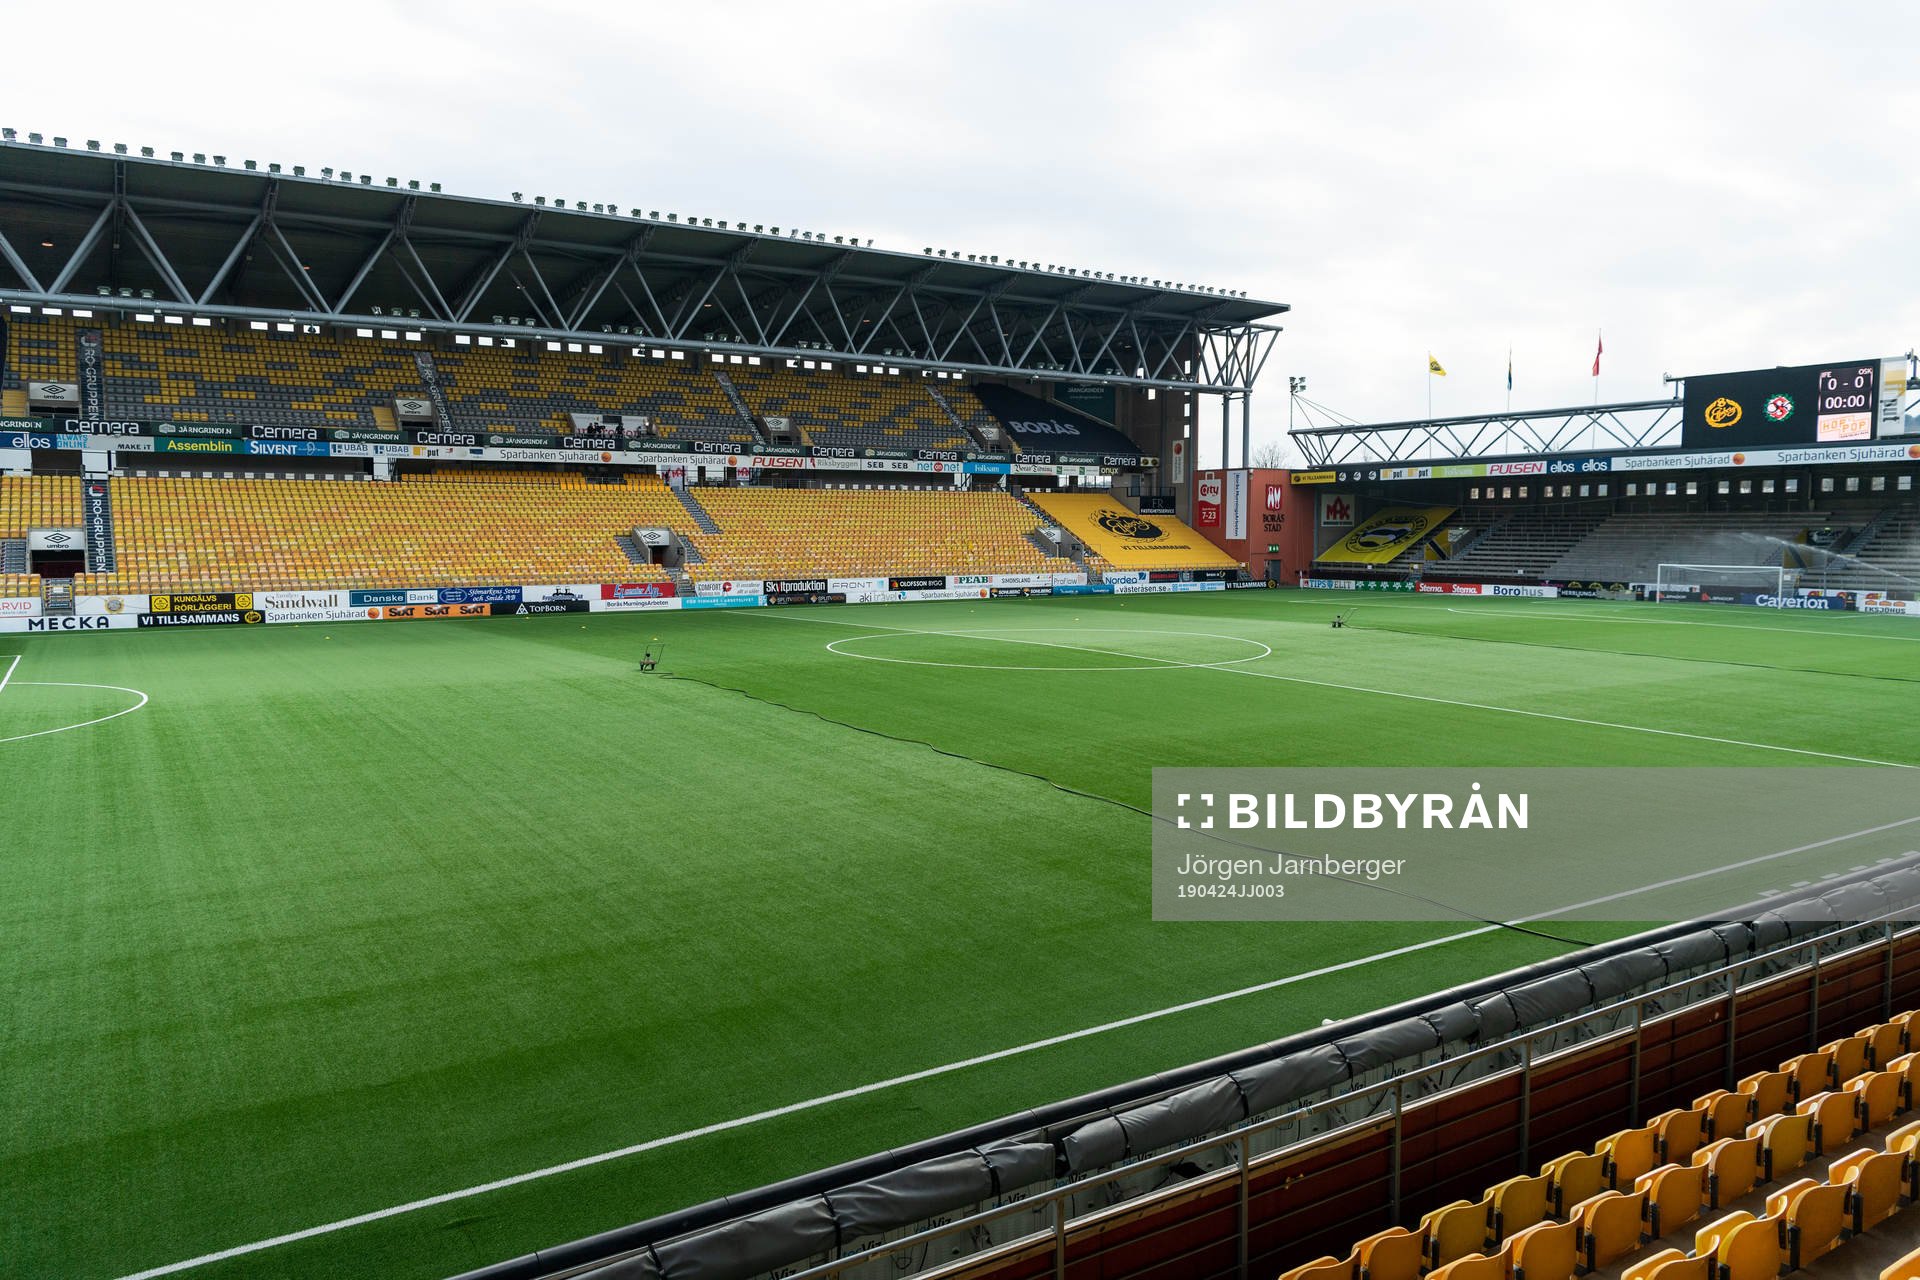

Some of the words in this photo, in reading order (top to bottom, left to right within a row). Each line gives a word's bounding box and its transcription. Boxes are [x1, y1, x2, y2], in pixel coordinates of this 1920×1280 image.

[1828, 378, 1837, 391] 0
[1855, 376, 1864, 388] 0
[1825, 395, 1865, 409] 00:00
[65, 419, 140, 434] Cernera
[252, 425, 318, 440] Cernera
[1009, 419, 1081, 436] BORÅS
[12, 432, 51, 448] ellos
[417, 431, 475, 445] Cernera
[563, 437, 616, 449] Cernera
[167, 440, 232, 452] Assemblin
[250, 440, 298, 455] SILVENT
[344, 444, 369, 452] UBAB
[385, 445, 409, 453] UBAB
[694, 441, 742, 453] Cernera
[812, 446, 855, 457] Cernera
[500, 450, 556, 460] Sparbanken
[559, 450, 599, 462] Sjuhärad
[637, 453, 688, 464] Sparbanken
[690, 454, 727, 467] Sjuhärad
[918, 449, 958, 461] Cernera
[1015, 453, 1051, 464] Cernera
[1103, 456, 1136, 466] Cernera
[1777, 450, 1847, 463] Sparbanken
[1849, 447, 1905, 461] Sjuhärad
[752, 457, 804, 468] PULSEN
[867, 461, 884, 469] SEB
[1550, 460, 1575, 473] ellos
[1581, 459, 1608, 472] ellos
[1625, 457, 1682, 469] Sparbanken
[1684, 454, 1730, 468] Sjuhärad
[1489, 463, 1543, 475] PULSEN
[1202, 511, 1217, 520] 7-23
[1263, 513, 1285, 522] BORÅS
[1264, 524, 1282, 532] STAD
[959, 576, 990, 584] PEAB
[1105, 576, 1138, 585] Nordea
[1232, 581, 1267, 589] TILLSAMMANS
[920, 591, 954, 599] Sparbanken
[1493, 585, 1544, 597] Borohus
[265, 594, 338, 609] Sandwall
[363, 593, 404, 603] Danske
[409, 593, 435, 601] Bank
[859, 592, 872, 603] aki
[1755, 593, 1829, 610] Caverion
[142, 616, 153, 625] VI
[156, 613, 240, 625] TILLSAMMANS
[268, 611, 324, 622] Sparbanken
[326, 609, 366, 620] Sjuhärad
[28, 616, 110, 631] MECKA
